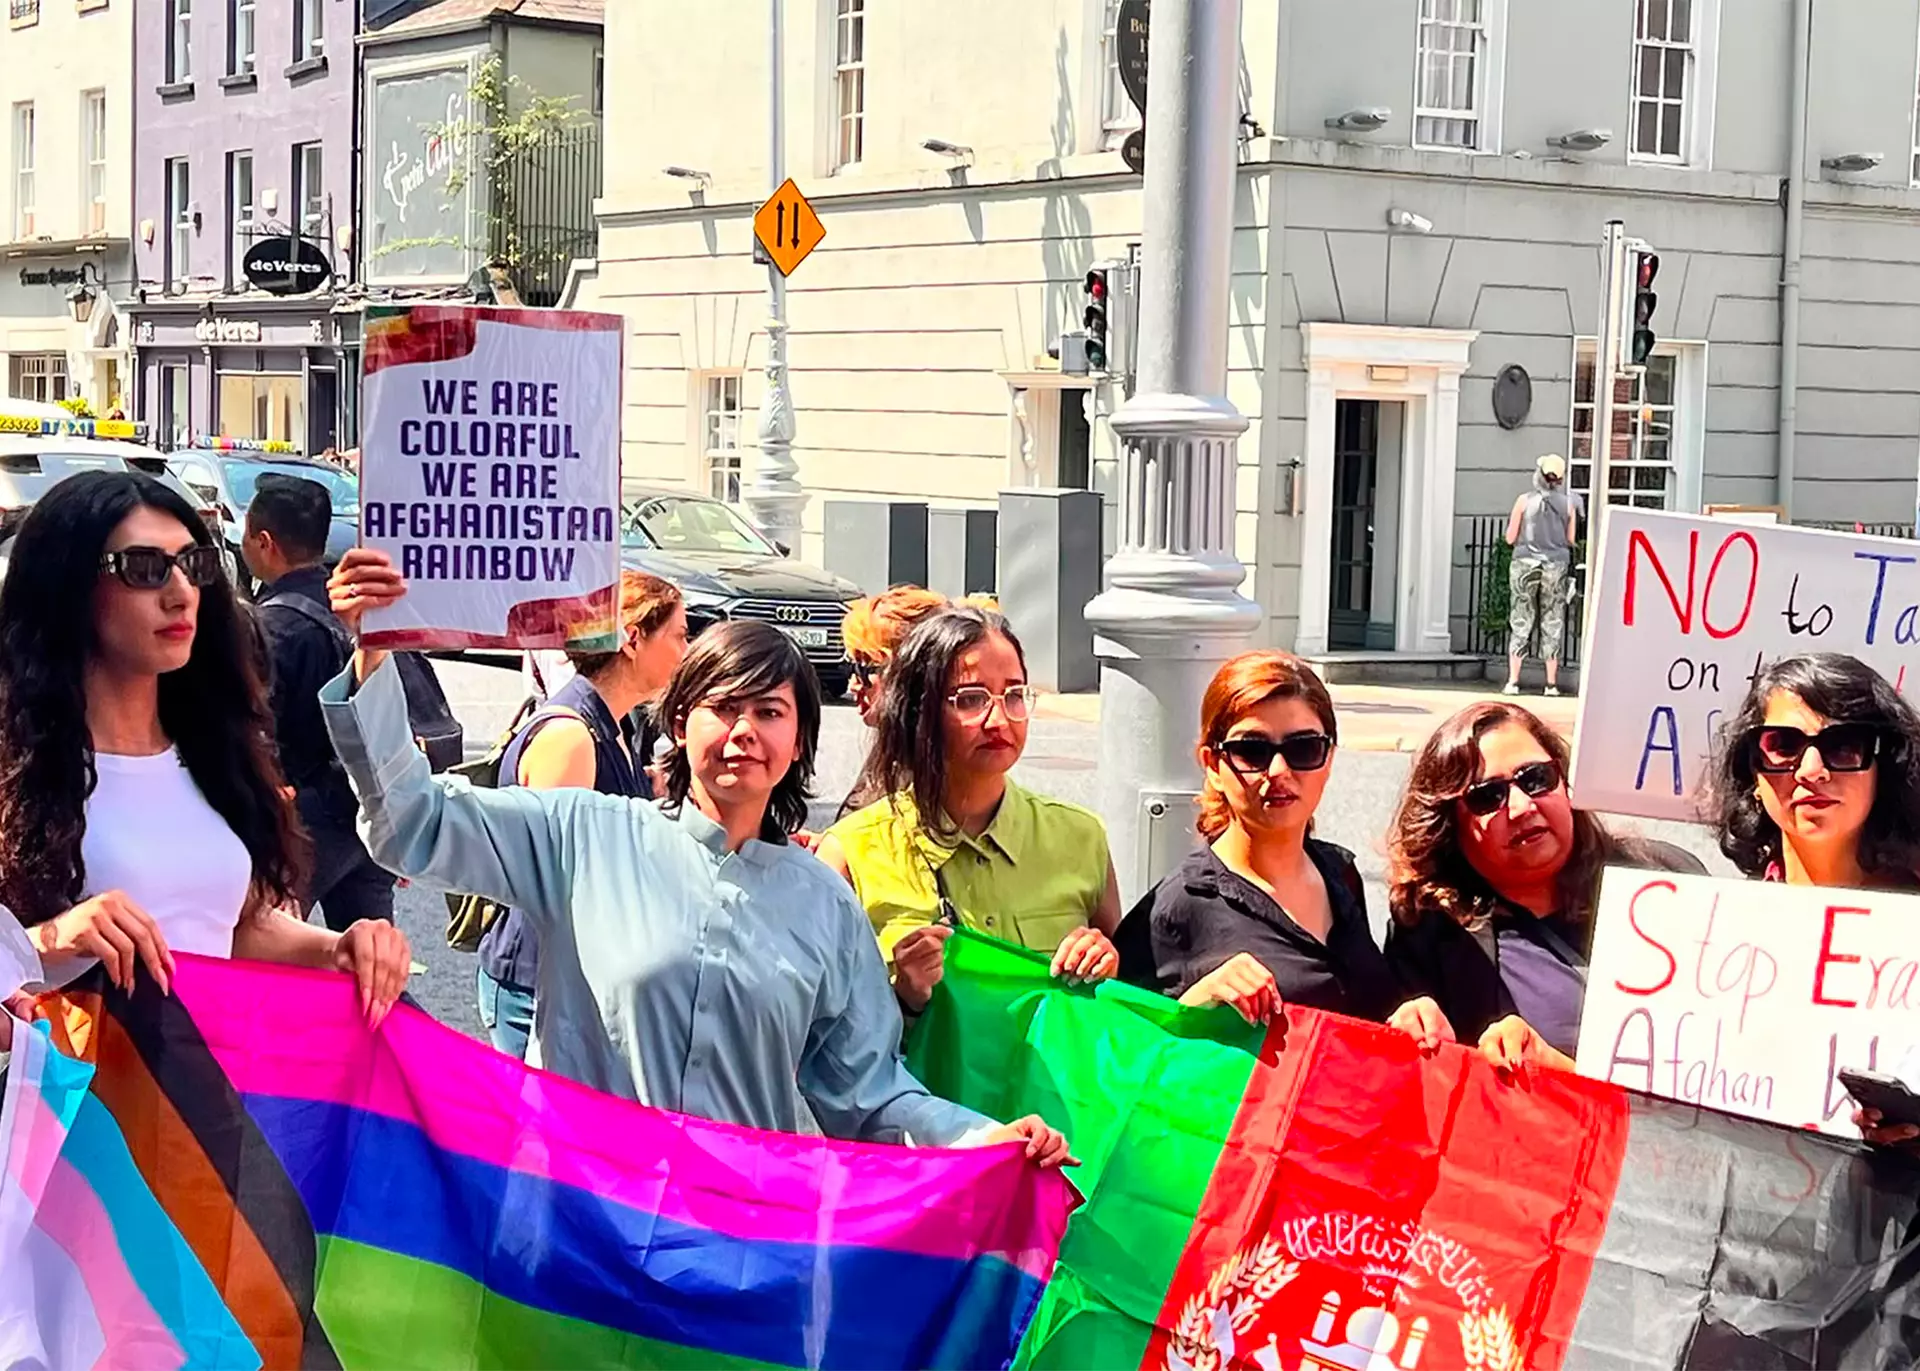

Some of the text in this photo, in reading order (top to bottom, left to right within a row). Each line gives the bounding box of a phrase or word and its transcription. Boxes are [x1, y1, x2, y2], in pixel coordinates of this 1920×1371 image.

[250, 259, 321, 273] deVeres
[195, 318, 261, 341] deVeres
[423, 379, 558, 417] WE ARE
[44, 418, 91, 436] TAXI
[400, 420, 580, 459] COLORFUL
[422, 462, 558, 499] WE ARE
[365, 502, 614, 542] AFGHANISTAN
[402, 544, 575, 582] RAINBOW
[1622, 530, 1760, 640] NO
[1781, 573, 1834, 636] to
[1668, 657, 1720, 692] on
[1614, 879, 1920, 1034] Stop Era
[1606, 1007, 1774, 1131] Afghan
